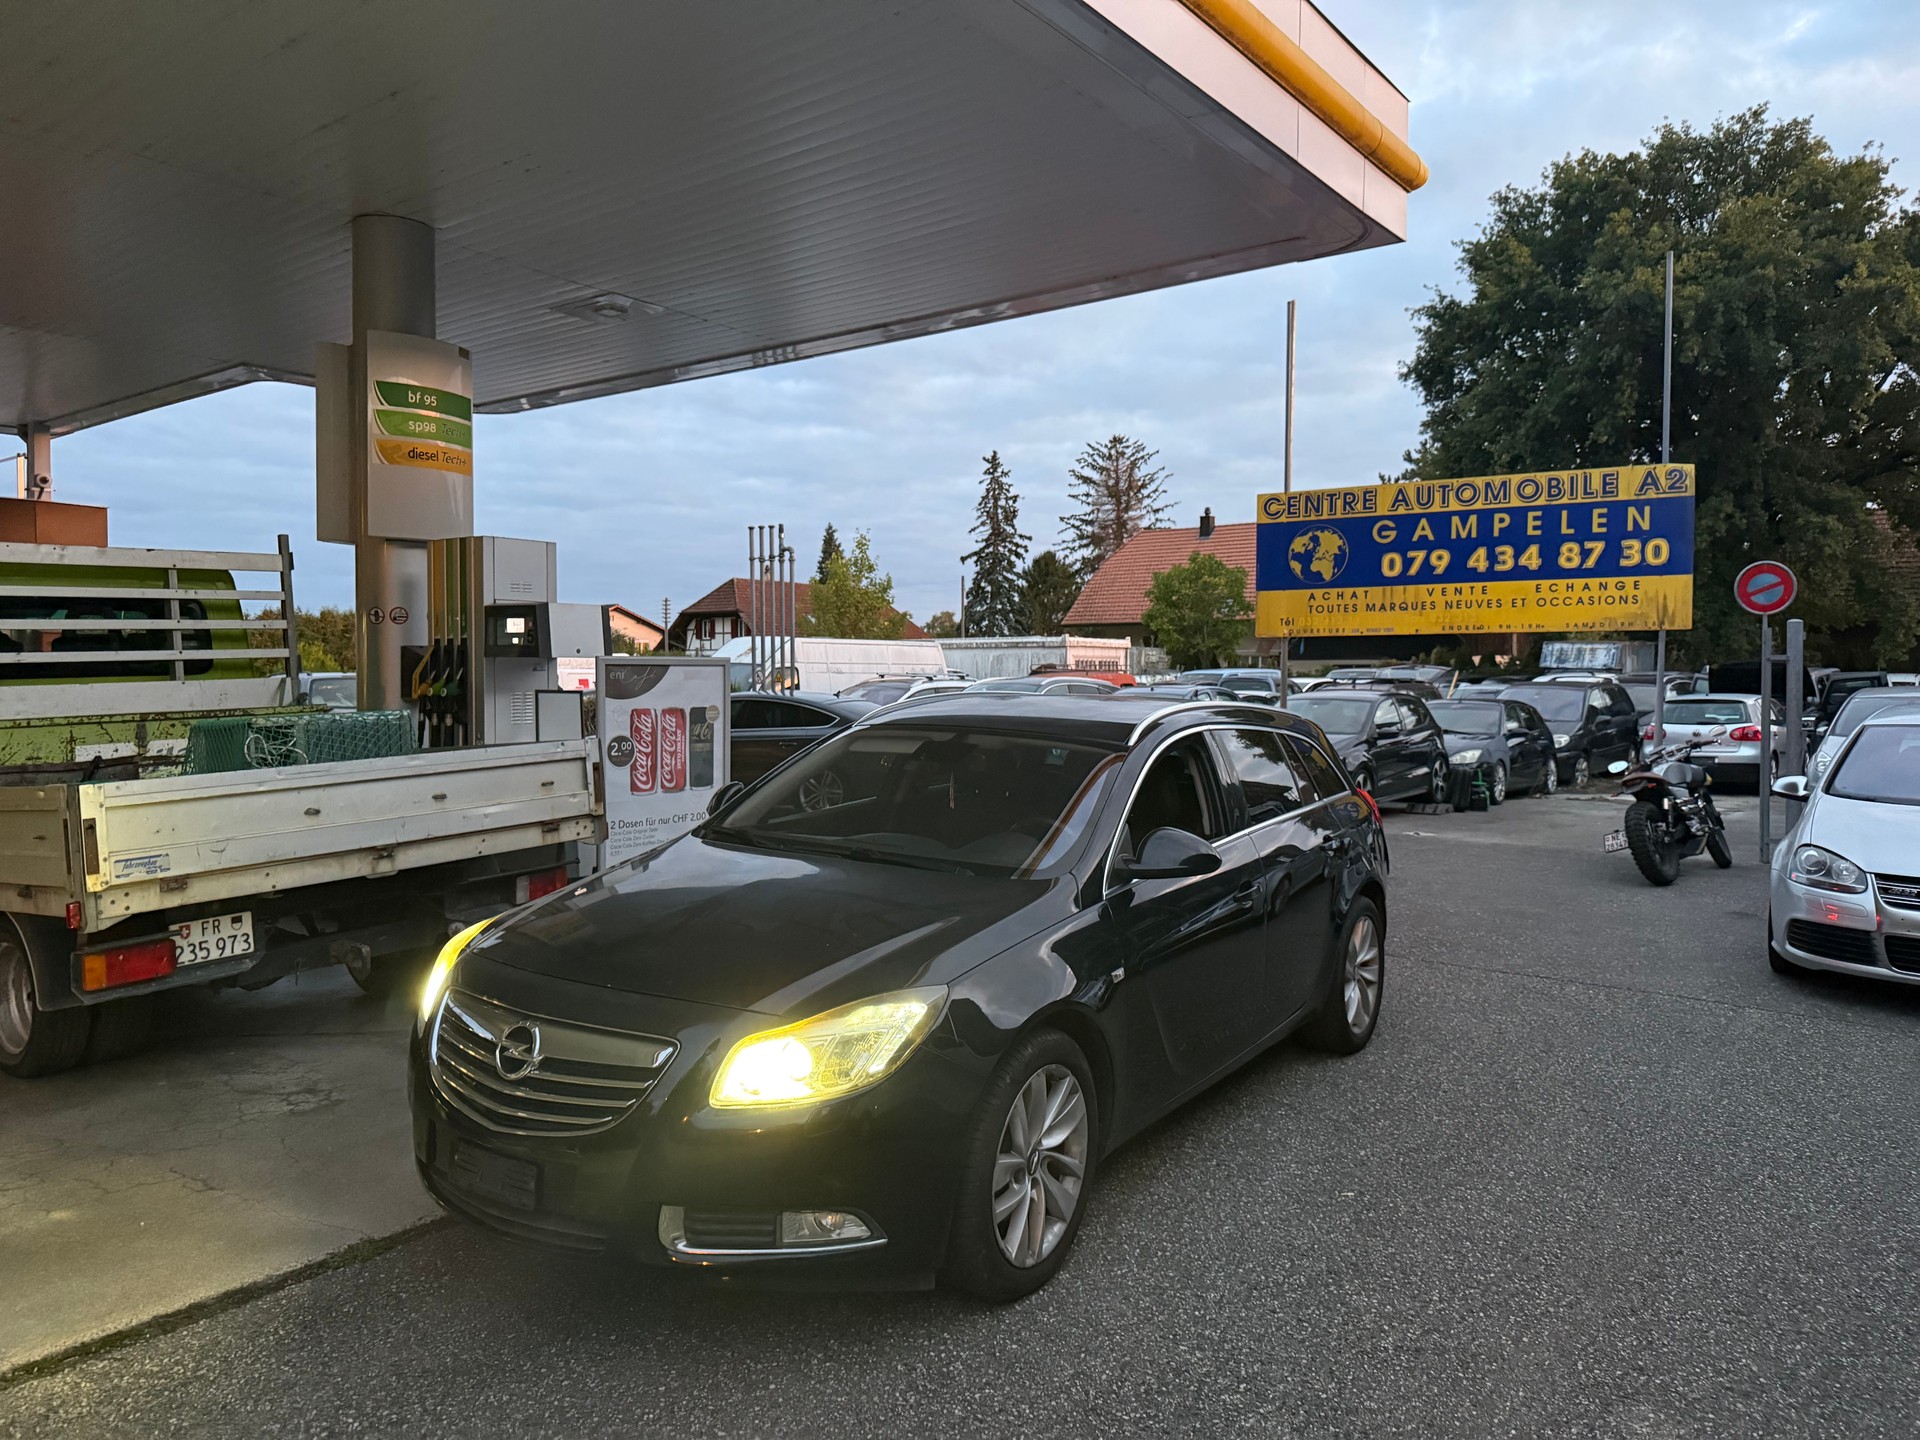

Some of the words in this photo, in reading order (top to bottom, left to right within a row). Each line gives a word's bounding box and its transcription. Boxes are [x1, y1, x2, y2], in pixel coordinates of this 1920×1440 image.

[408, 390, 421, 403] bf
[424, 394, 437, 406] 95
[408, 420, 436, 433] sp98
[408, 448, 438, 462] diesel
[442, 452, 466, 466] Tech+
[1262, 489, 1376, 520] CENTRE
[1388, 471, 1618, 510] AUTOMOBILE
[1634, 469, 1689, 496] A2
[1372, 506, 1650, 544] GAMPELEN
[1381, 548, 1452, 578] 079
[1467, 544, 1542, 574] 434
[1558, 540, 1607, 570] 87
[1619, 538, 1671, 568] 30
[1308, 590, 1370, 602] ACHAT
[1426, 585, 1489, 598] VENTE
[1536, 580, 1641, 594] ECHANGE
[1308, 604, 1358, 614] TOUTES
[1366, 601, 1436, 612] MARQUES
[1444, 598, 1504, 610] NEUVES
[1512, 598, 1527, 608] ET
[1536, 594, 1640, 608] OCCASIONS
[1280, 618, 1294, 627] Tél
[527, 629, 534, 644] 5
[610, 669, 624, 680] eni
[611, 742, 632, 756] 2.00
[610, 820, 616, 830] 2
[618, 820, 644, 829] Dosen
[646, 818, 656, 826] für
[673, 813, 688, 824] CHF
[690, 812, 706, 822] 2.00
[202, 919, 221, 936] FR
[176, 940, 210, 965] 235
[216, 932, 251, 957] 973
